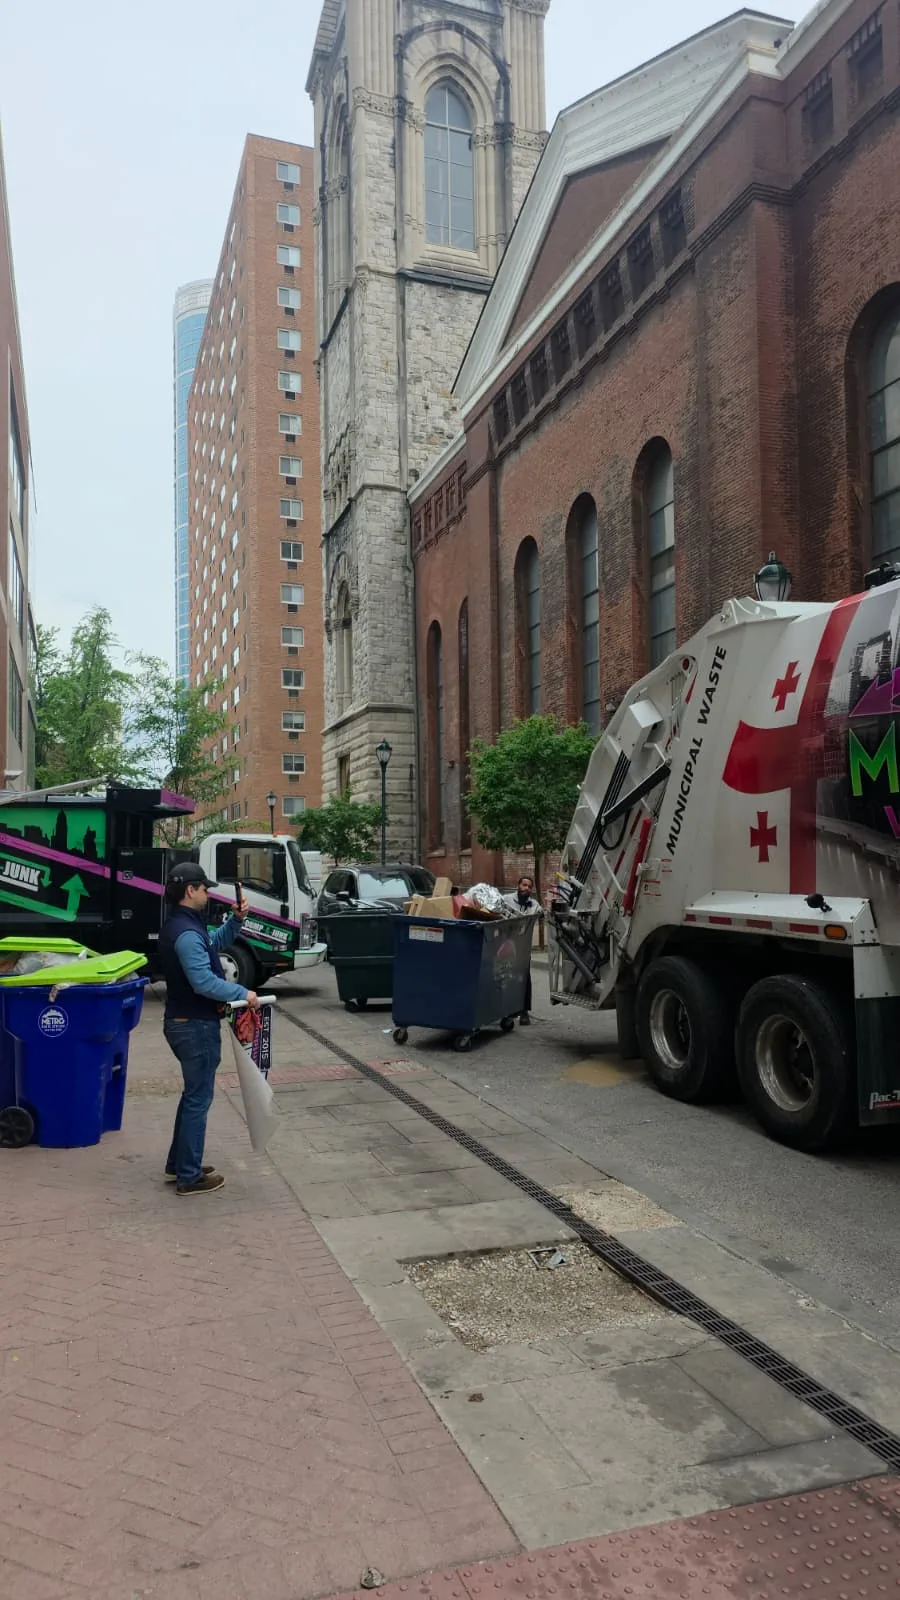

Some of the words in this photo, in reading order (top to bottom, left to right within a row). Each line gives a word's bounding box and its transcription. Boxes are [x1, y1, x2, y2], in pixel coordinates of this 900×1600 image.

[666, 737, 703, 855] MUNICIPAL
[697, 645, 727, 724] WASTE
[2, 860, 40, 885] JUNK
[271, 928, 288, 942] JUNK
[41, 1016, 65, 1025] METRO
[261, 1037, 269, 1060] 2015
